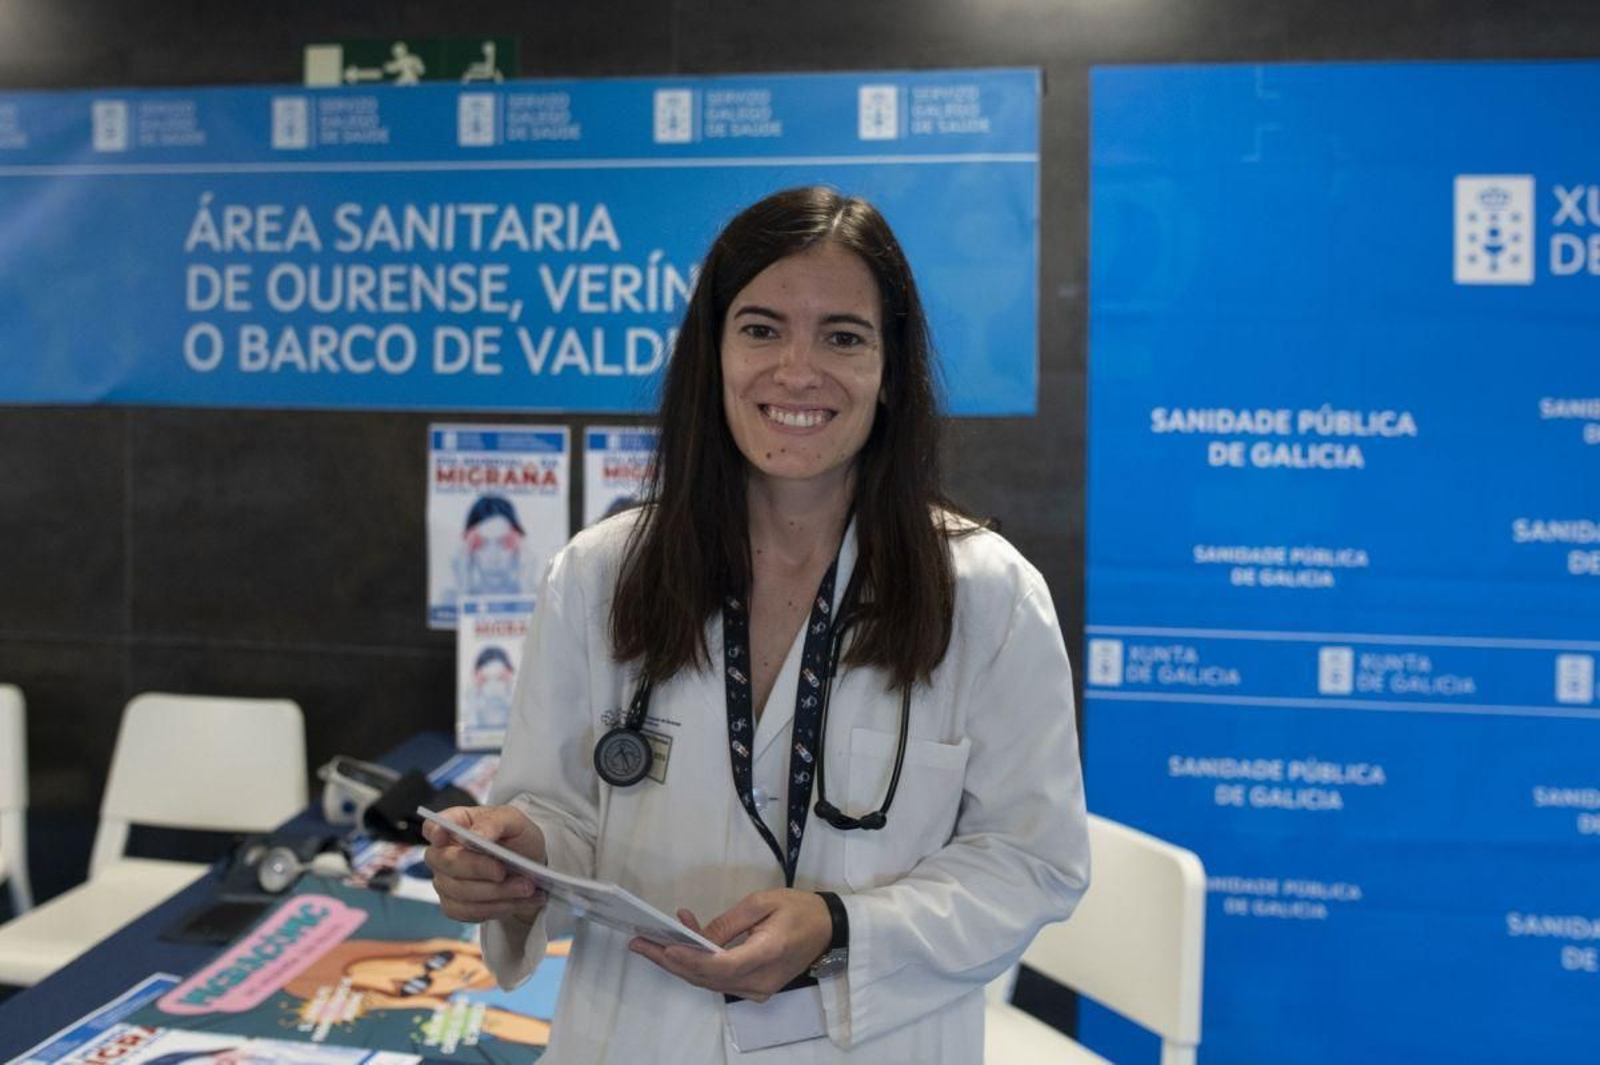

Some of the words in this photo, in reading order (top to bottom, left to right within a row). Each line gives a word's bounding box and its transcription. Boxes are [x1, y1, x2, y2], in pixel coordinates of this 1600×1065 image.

[183, 190, 322, 253] ÁREA
[334, 203, 621, 253] SANITARIA
[185, 264, 253, 313] DE
[266, 262, 523, 322] OURENSE,
[183, 321, 224, 373] O
[238, 324, 417, 374] BARCO
[433, 326, 503, 375] DE
[1150, 407, 1291, 435] SANIDADE
[1297, 404, 1418, 437] PÚBLICA
[1207, 441, 1245, 467] DE
[1251, 442, 1365, 469] GALICIA
[1193, 544, 1287, 566] SANIDADE
[1230, 566, 1255, 587] DE
[1258, 567, 1335, 588] GALICIA
[1168, 755, 1284, 782] SANIDADE
[1214, 783, 1245, 807] DE
[1250, 784, 1344, 811] GALICIA
[1561, 945, 1599, 973] DE
